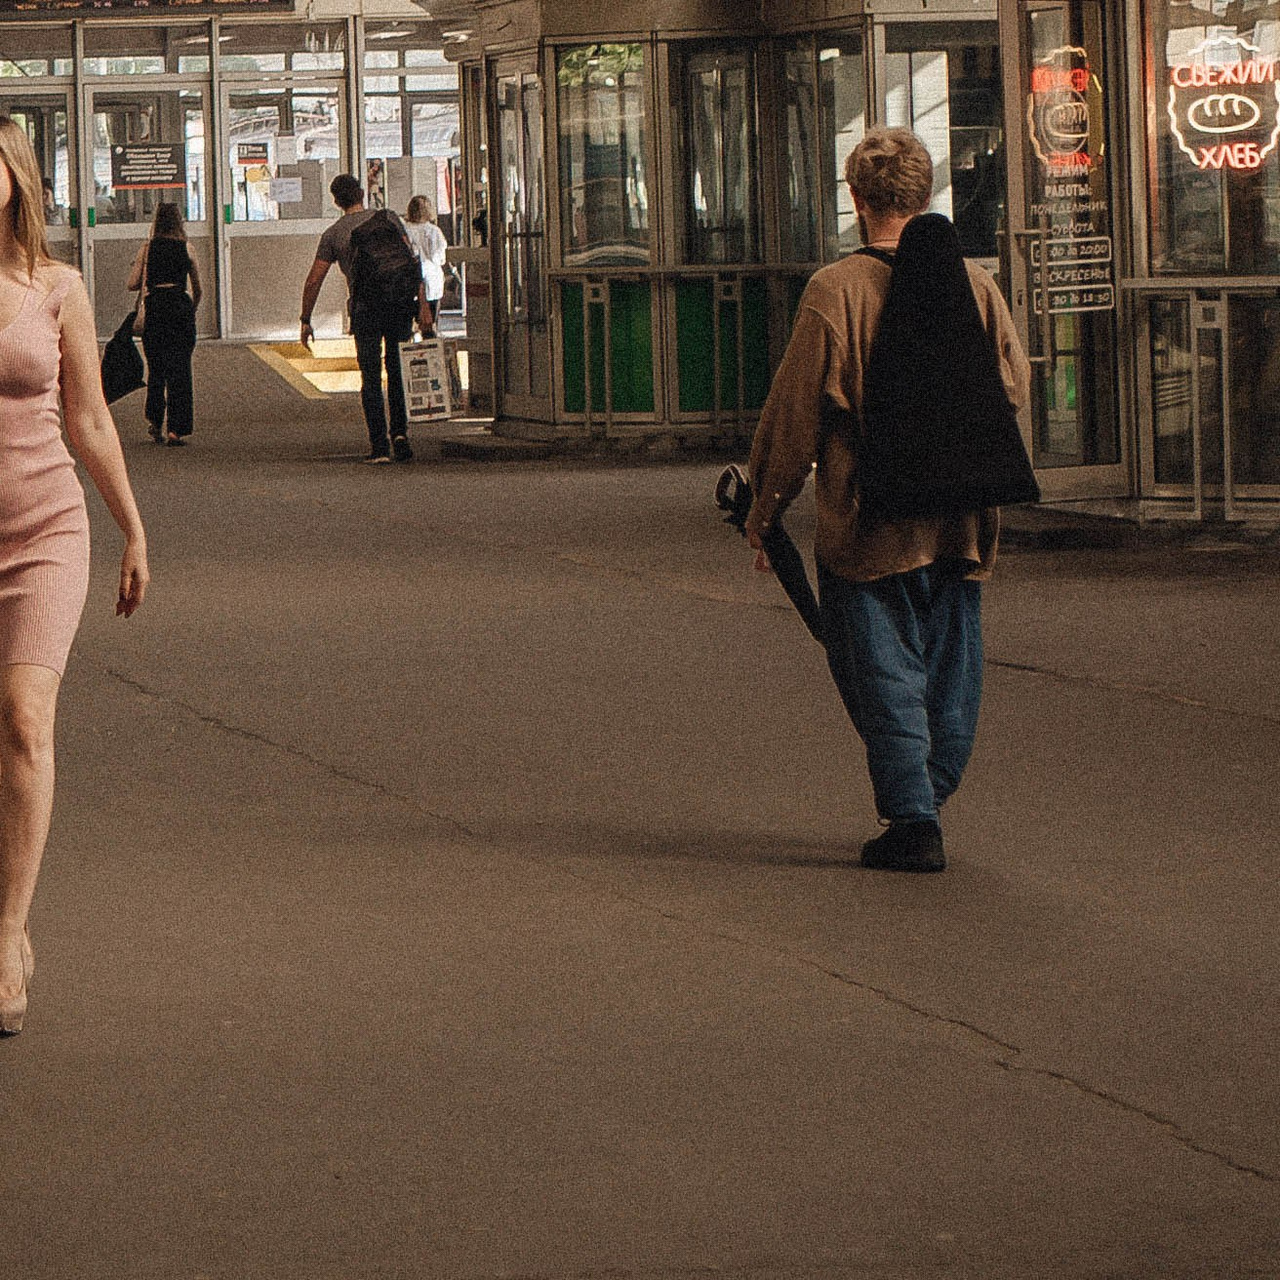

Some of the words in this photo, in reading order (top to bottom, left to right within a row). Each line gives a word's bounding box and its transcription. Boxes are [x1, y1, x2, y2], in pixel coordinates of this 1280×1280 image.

[1199, 143, 1261, 169] ХЛЕБ
[1046, 165, 1089, 177] РЕЖИМ
[1045, 184, 1093, 197] РАБОТЫ:
[1033, 268, 1110, 284] ВСКРЕСЕНЬЕ
